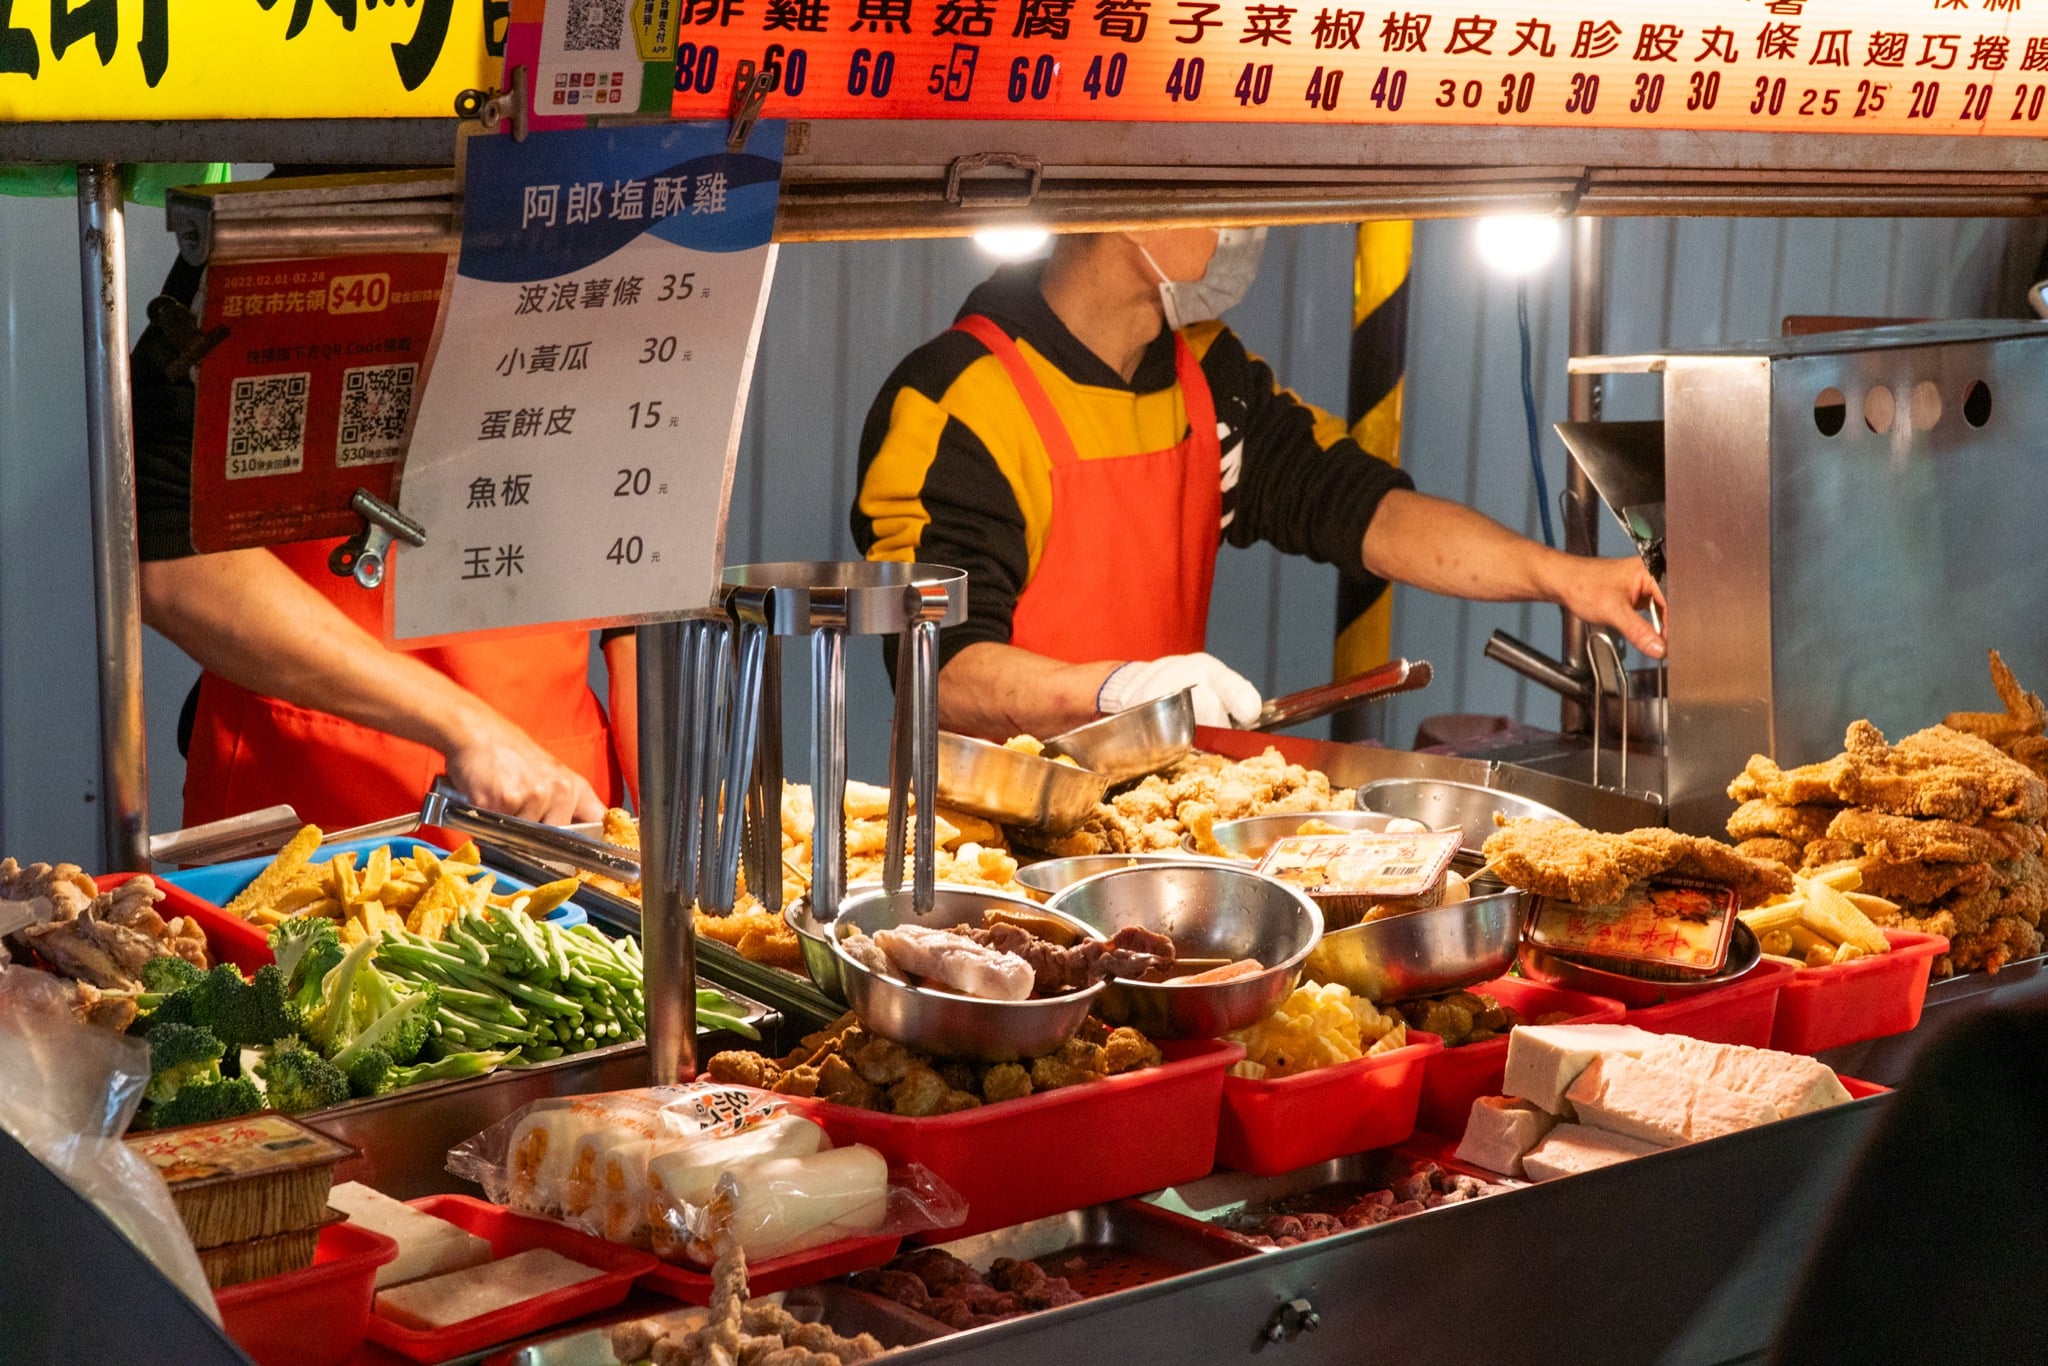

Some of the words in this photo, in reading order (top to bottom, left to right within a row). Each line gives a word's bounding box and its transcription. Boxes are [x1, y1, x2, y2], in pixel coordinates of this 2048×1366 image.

[932, 0, 996, 37] 菇
[1011, 0, 1081, 40] 腐
[1093, 0, 1155, 43] 筍
[1168, 1, 1224, 44] 子
[1239, 3, 1298, 47] 菜
[1310, 7, 1366, 50] 椒
[1378, 11, 1433, 52] 椒
[1443, 14, 1498, 55] 皮
[1507, 17, 1557, 58] 丸
[1632, 23, 1684, 62] 股
[1693, 25, 1739, 63] 丸
[1808, 29, 1853, 67] 瓜
[1863, 30, 1910, 68] 翅
[1915, 34, 1962, 70] 巧
[1967, 34, 2011, 71] 捲
[675, 42, 720, 94] 80
[762, 43, 808, 97] 60
[847, 47, 896, 98] 60
[927, 42, 980, 101] 55
[1007, 53, 1055, 103] 60
[1083, 52, 1128, 100] 40
[1165, 56, 1205, 102] 40
[1234, 62, 1274, 106] 40
[1305, 66, 1345, 111] 40
[1370, 66, 1408, 112] 40
[1435, 79, 1483, 108] 30
[1497, 72, 1536, 115] 30
[1565, 72, 1600, 115] 30
[1630, 72, 1665, 114] 30
[1687, 70, 1721, 111] 30
[1750, 75, 1787, 116] 30
[1798, 88, 1841, 116] 25
[1852, 79, 1888, 118] 25
[1907, 80, 1940, 119] 20
[1959, 83, 1993, 121] 20
[2010, 84, 2047, 121] 20
[521, 171, 729, 230] 阿郎塩酥雞
[222, 287, 327, 318] 逛夜市先領
[331, 276, 388, 311] $40
[513, 276, 644, 316] 波浪薯條
[656, 273, 696, 302] 35
[700, 288, 711, 299] 元
[495, 341, 593, 377] 小黃瓜
[638, 336, 678, 364] 30
[682, 351, 693, 362] 元
[476, 405, 577, 441] 蛋餅皮
[627, 401, 663, 430] 15
[668, 416, 679, 428] 元
[466, 474, 533, 510] 魚板
[613, 467, 652, 497] 20
[658, 483, 669, 495] 元
[461, 543, 525, 581] 玉米
[606, 536, 644, 566] 40
[650, 551, 661, 563] 元
